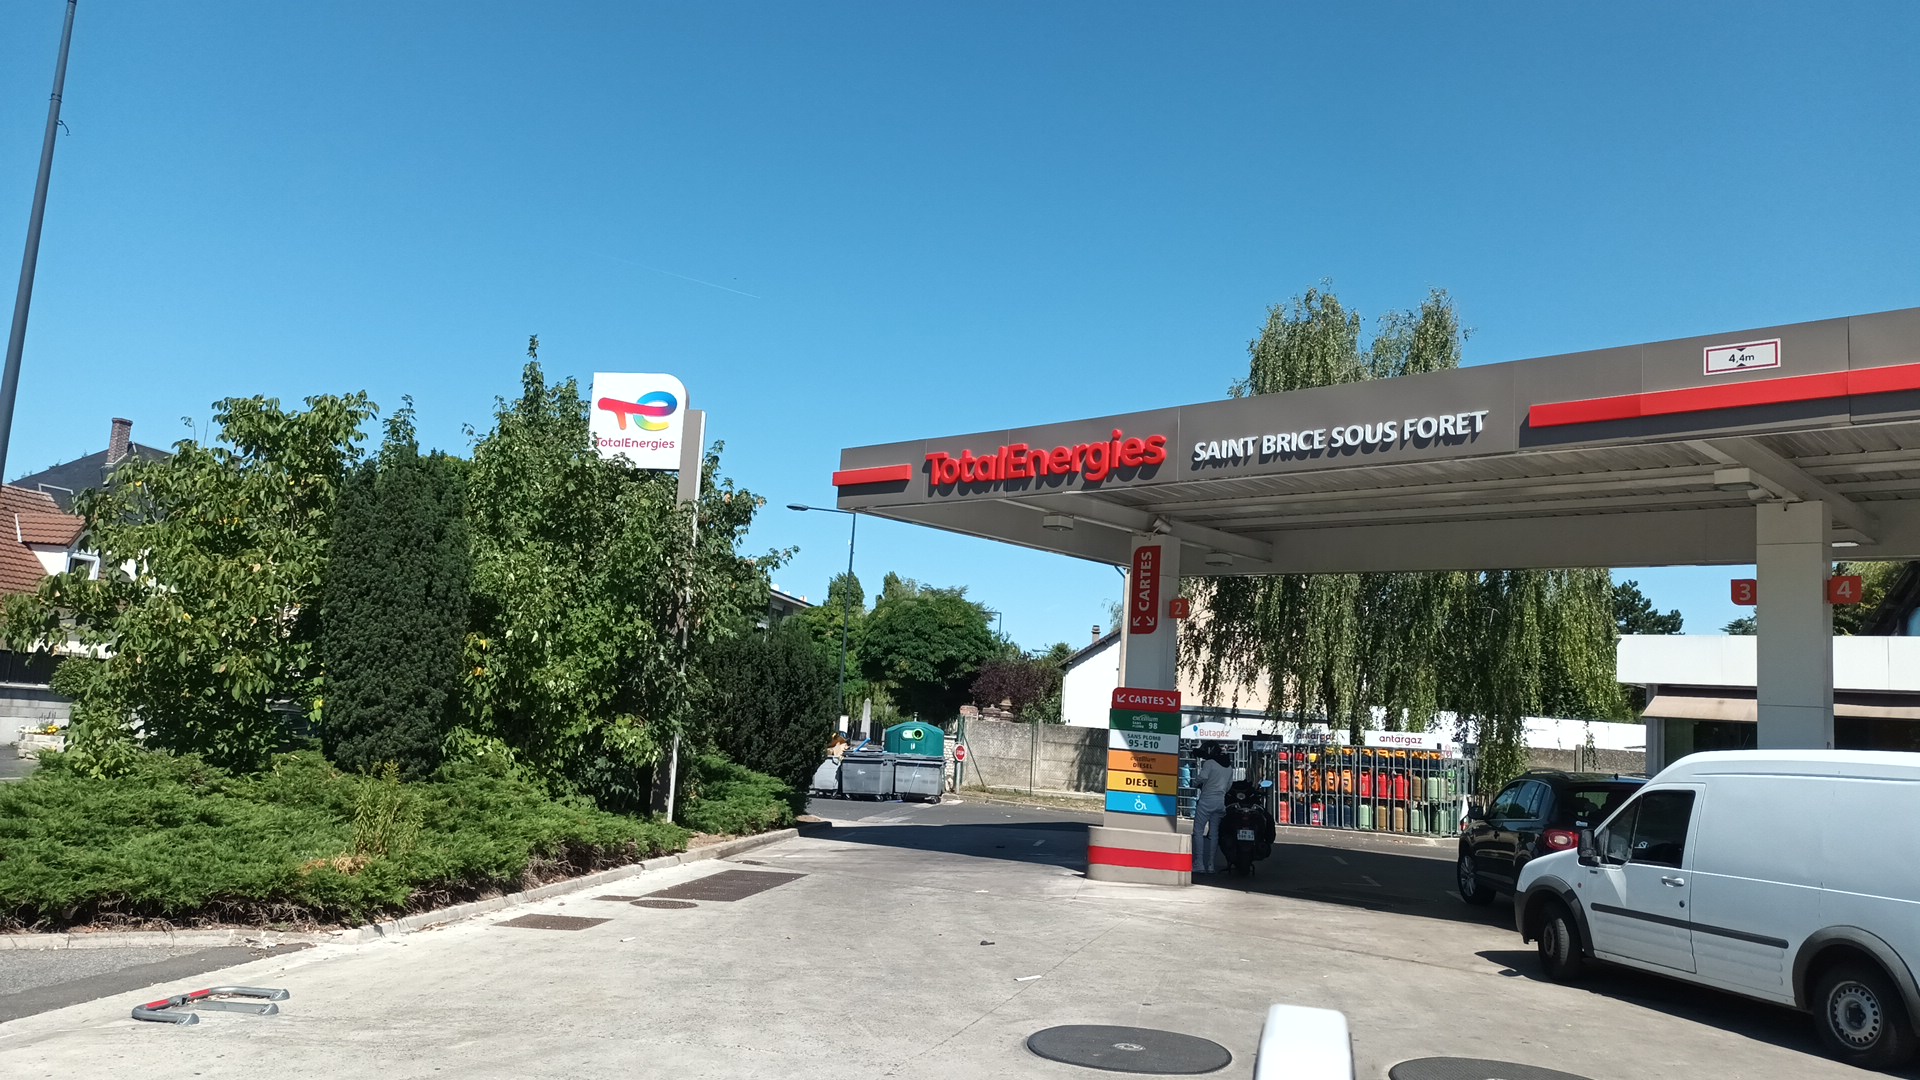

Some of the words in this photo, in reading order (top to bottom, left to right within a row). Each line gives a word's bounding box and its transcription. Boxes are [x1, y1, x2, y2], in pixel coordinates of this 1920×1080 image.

[1728, 353, 1755, 364] 4,4m
[1194, 435, 1258, 462] SAINT
[1262, 428, 1326, 455] BRICE
[1331, 421, 1397, 448] SOUS
[1404, 410, 1489, 440] FORET
[596, 437, 675, 450] TotalEnergies
[925, 429, 1167, 485] TotalEnergies
[1138, 551, 1151, 611] CARTES
[1739, 583, 1751, 600] 3
[1836, 580, 1852, 598] 4
[1174, 602, 1182, 615] 2
[1128, 695, 1164, 705] CARTES
[1148, 722, 1158, 730] 98
[1199, 729, 1229, 738] Butagaz
[1128, 739, 1159, 749] 95-E10
[1379, 735, 1423, 746] antargaz
[1125, 778, 1158, 787] DIESEL
